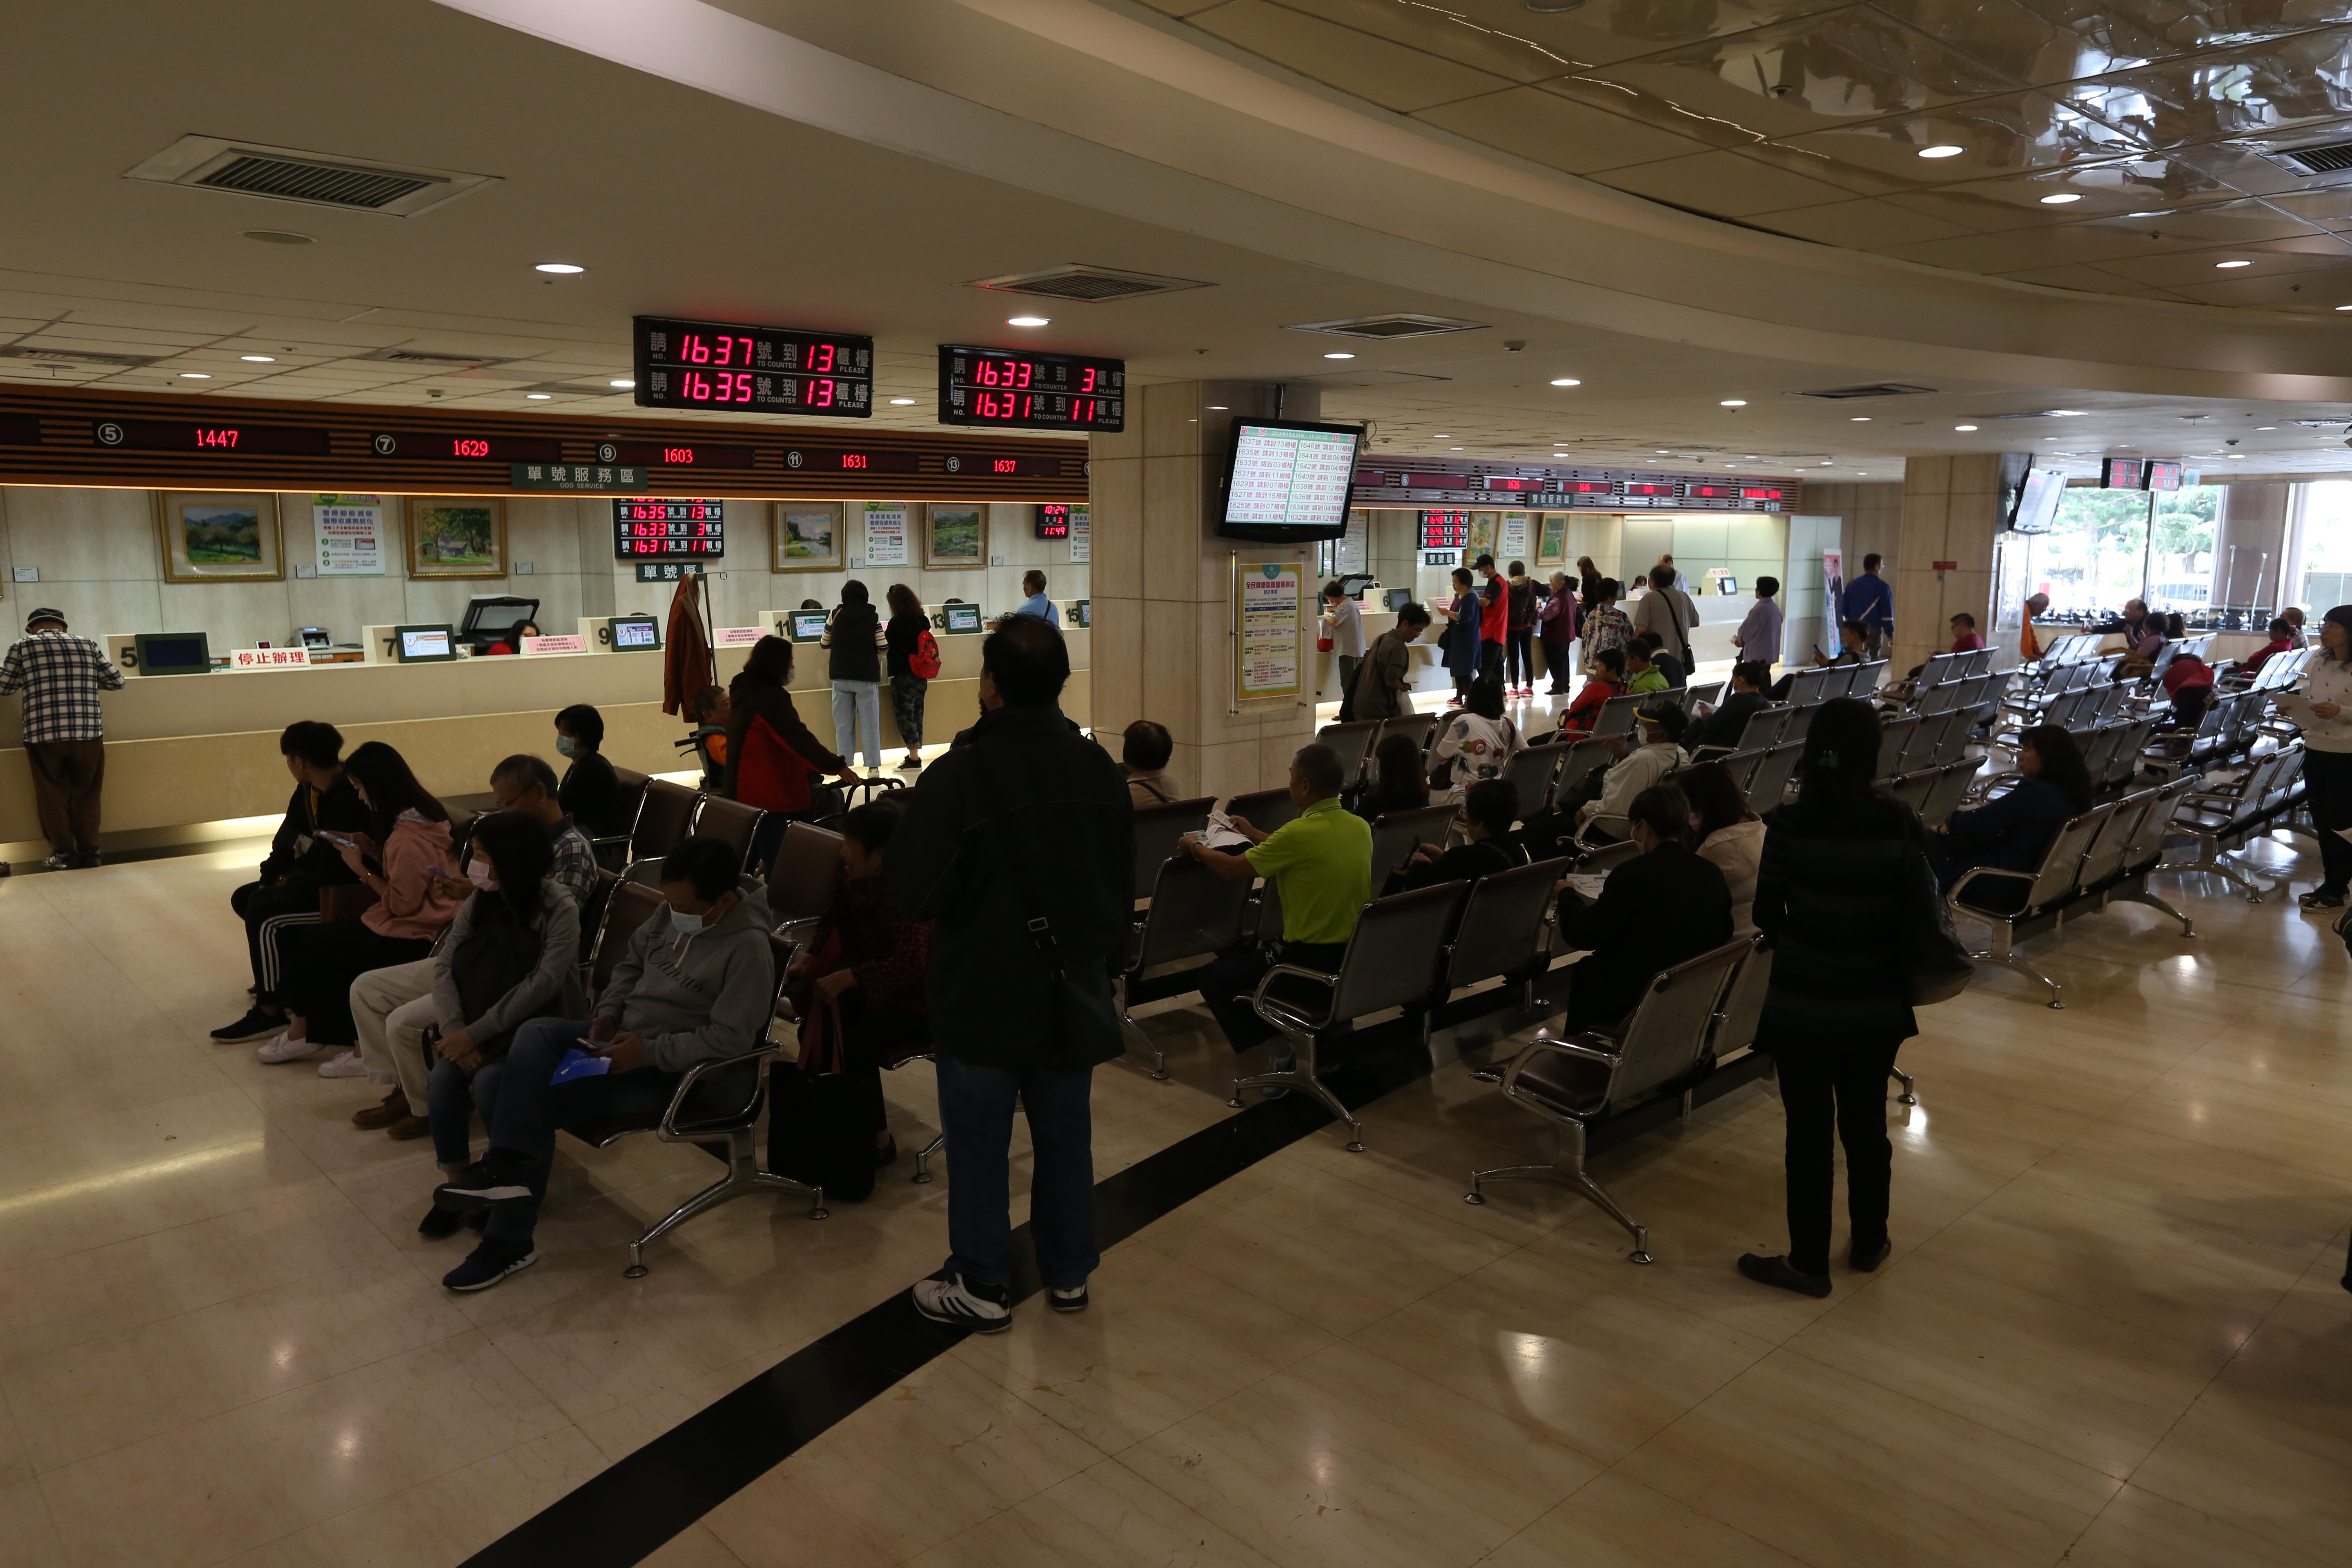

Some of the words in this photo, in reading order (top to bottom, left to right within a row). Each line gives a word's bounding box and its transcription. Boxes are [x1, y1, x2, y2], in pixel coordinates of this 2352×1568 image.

[651, 332, 666, 351] 請
[682, 335, 753, 365] 1637
[757, 342, 797, 361] 號到
[808, 345, 834, 372] 13
[837, 347, 869, 367] 櫃檯
[954, 358, 965, 374] 請
[976, 361, 1031, 387] 1633
[1034, 364, 1066, 381] 號到
[1082, 368, 1095, 391] 3
[1097, 370, 1122, 386] 櫃檯
[651, 372, 667, 391] 請
[684, 372, 752, 401] 1635
[757, 377, 796, 396] 號到
[808, 380, 833, 406] 13
[836, 383, 868, 401] 櫃檯
[953, 390, 964, 406] 請
[977, 393, 1031, 417] 1631
[1034, 395, 1065, 412] 號到
[1074, 400, 1094, 421] 11
[1096, 400, 1121, 416] 櫃檯
[105, 427, 117, 441] 5
[197, 429, 238, 447] 1447
[1241, 427, 1267, 436] 單號
[380, 438, 390, 451] 7
[454, 440, 488, 456] 1629
[604, 448, 612, 458] 9
[664, 448, 693, 463] 1603
[790, 454, 799, 465] 11
[843, 454, 866, 468] 1631
[949, 459, 958, 469] 13
[994, 460, 1016, 472] 1637
[528, 466, 634, 483] 單號服務區
[1508, 480, 1520, 489] 1626
[1579, 483, 1590, 492] 1646
[620, 507, 628, 516] 請
[634, 506, 666, 519] 1635
[667, 507, 687, 515] 號到
[692, 506, 705, 519] 13
[705, 507, 721, 516] 櫃檯
[1429, 515, 1444, 525] 1648
[1454, 515, 1461, 525] 12
[621, 524, 629, 532] 請
[635, 523, 667, 536] 1633
[668, 523, 687, 532] 號到
[697, 523, 706, 536] 3
[706, 524, 722, 532] 櫃檯
[1429, 526, 1443, 535] 1646
[1454, 526, 1460, 535] 10
[622, 540, 630, 550] 請
[635, 539, 667, 553] 1631
[668, 541, 687, 549] 號到
[693, 540, 706, 552] 11
[706, 541, 722, 549] 櫃檯
[1429, 537, 1443, 546] 1644
[1455, 537, 1460, 546] 6
[1383, 596, 1389, 607] 6
[931, 614, 945, 629] 13
[1066, 608, 1079, 622] 15
[776, 620, 791, 636] 11
[599, 628, 610, 645] 9
[383, 638, 396, 656] 7
[121, 647, 138, 667] 5
[238, 651, 305, 665] 停止辦理
